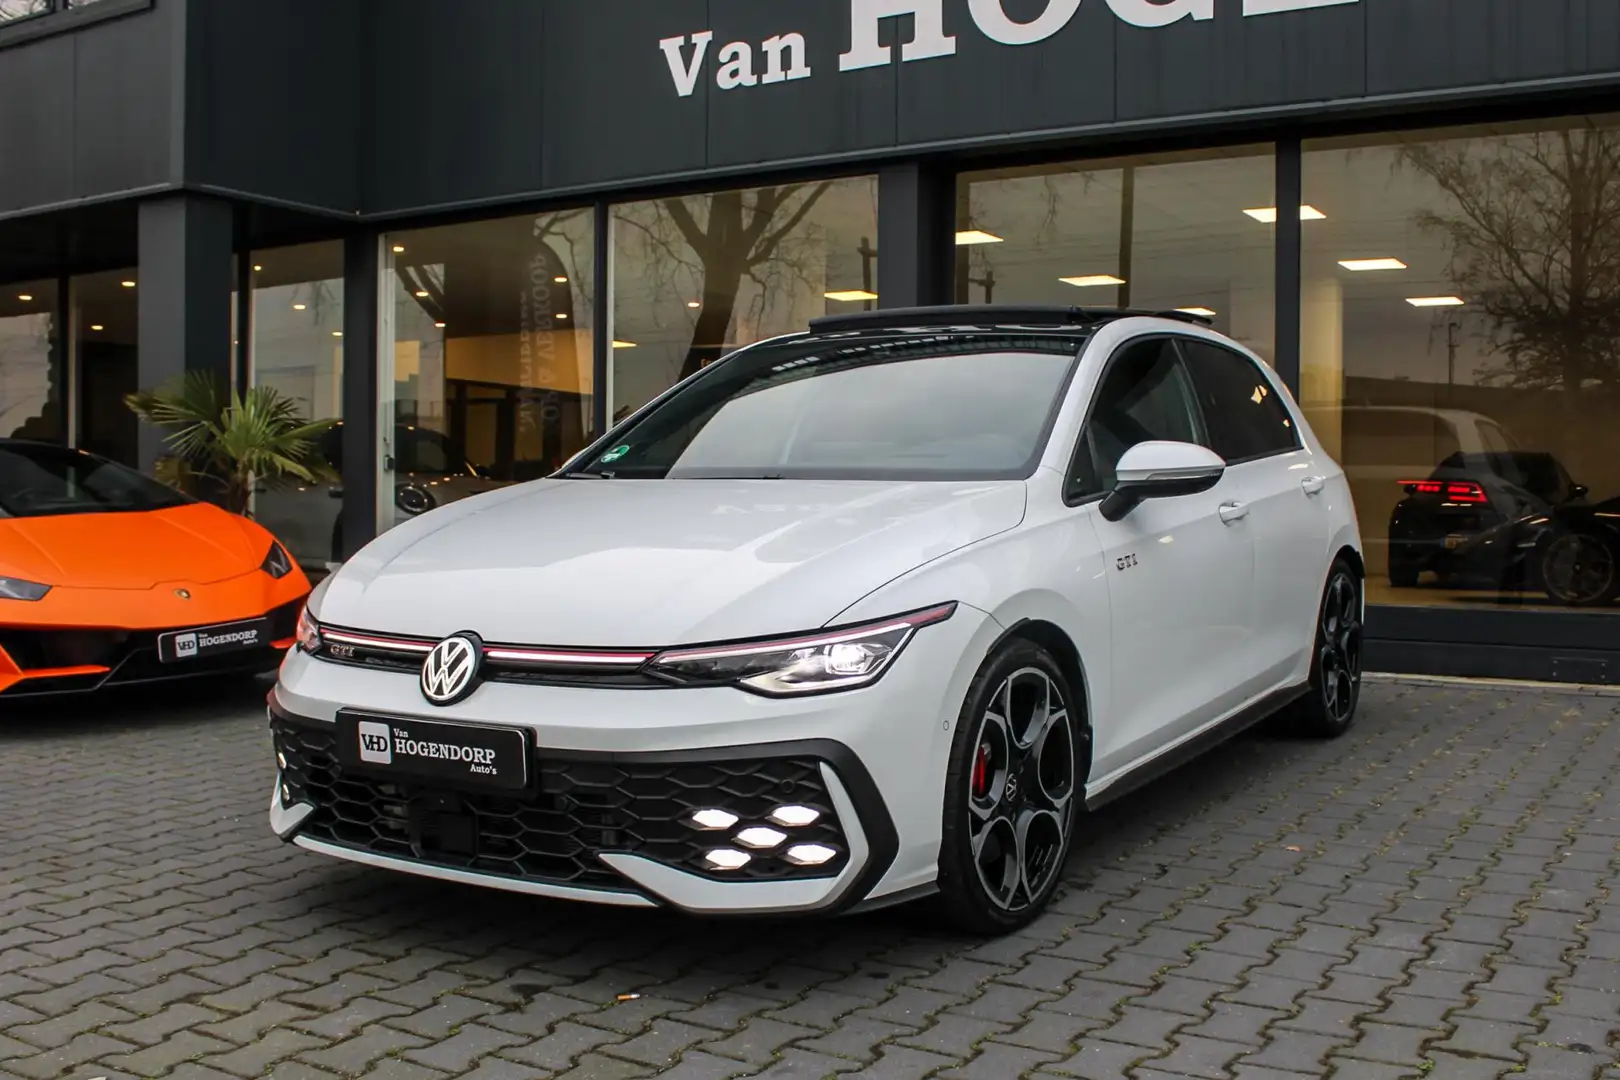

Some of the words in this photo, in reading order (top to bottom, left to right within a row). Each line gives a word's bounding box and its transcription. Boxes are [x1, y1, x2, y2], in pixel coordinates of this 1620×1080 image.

[659, 30, 811, 97] Van
[1116, 553, 1138, 571] GTI
[199, 630, 257, 647] HOGENDORP
[330, 643, 355, 657] GTI
[393, 728, 408, 738] Van
[395, 738, 496, 764] HOGENDORP
[470, 763, 497, 775] Auto's
